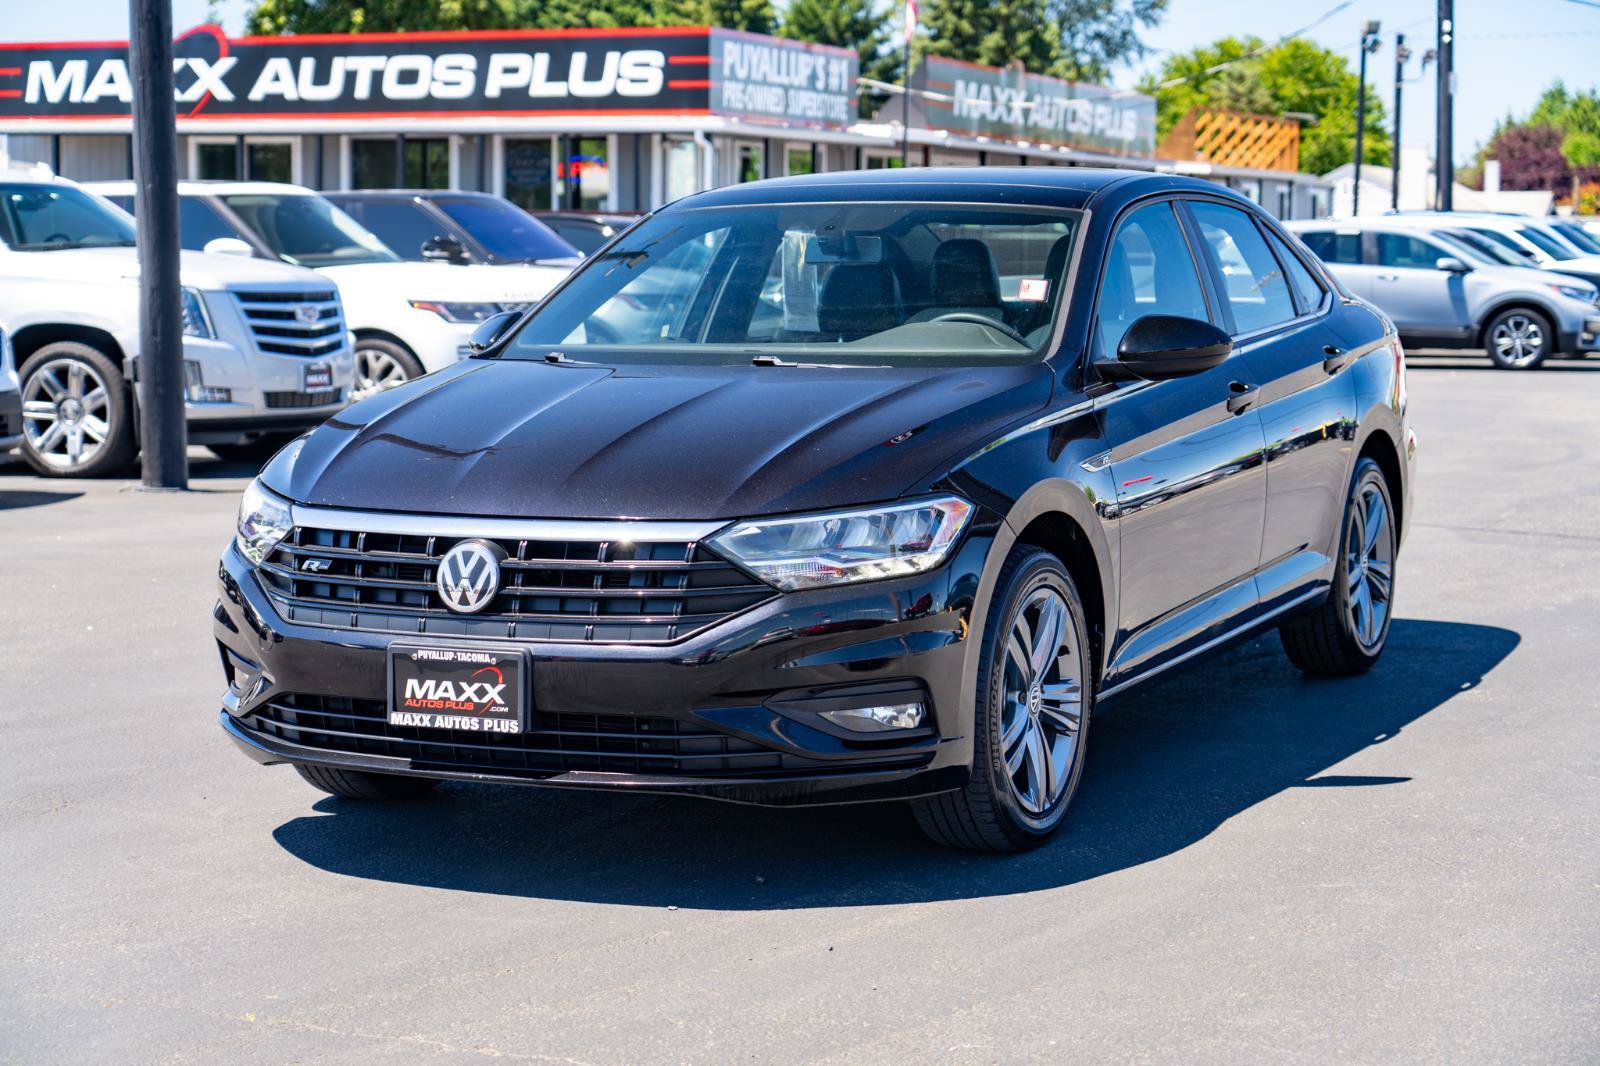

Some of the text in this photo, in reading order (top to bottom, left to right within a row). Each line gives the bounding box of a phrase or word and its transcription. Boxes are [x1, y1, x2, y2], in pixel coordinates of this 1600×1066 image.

[25, 49, 666, 103] MAX AUTOS PLUS
[722, 40, 849, 92] PUYALLUP'S #1
[722, 80, 849, 120] PRE-OWNED SUPERSTORE
[952, 79, 1138, 141] MAXX AUTOS PLUS
[404, 678, 507, 705] MAXX
[404, 698, 475, 711] AUTOS PLUS
[390, 712, 519, 733] MAXX AUTOS PLUS
